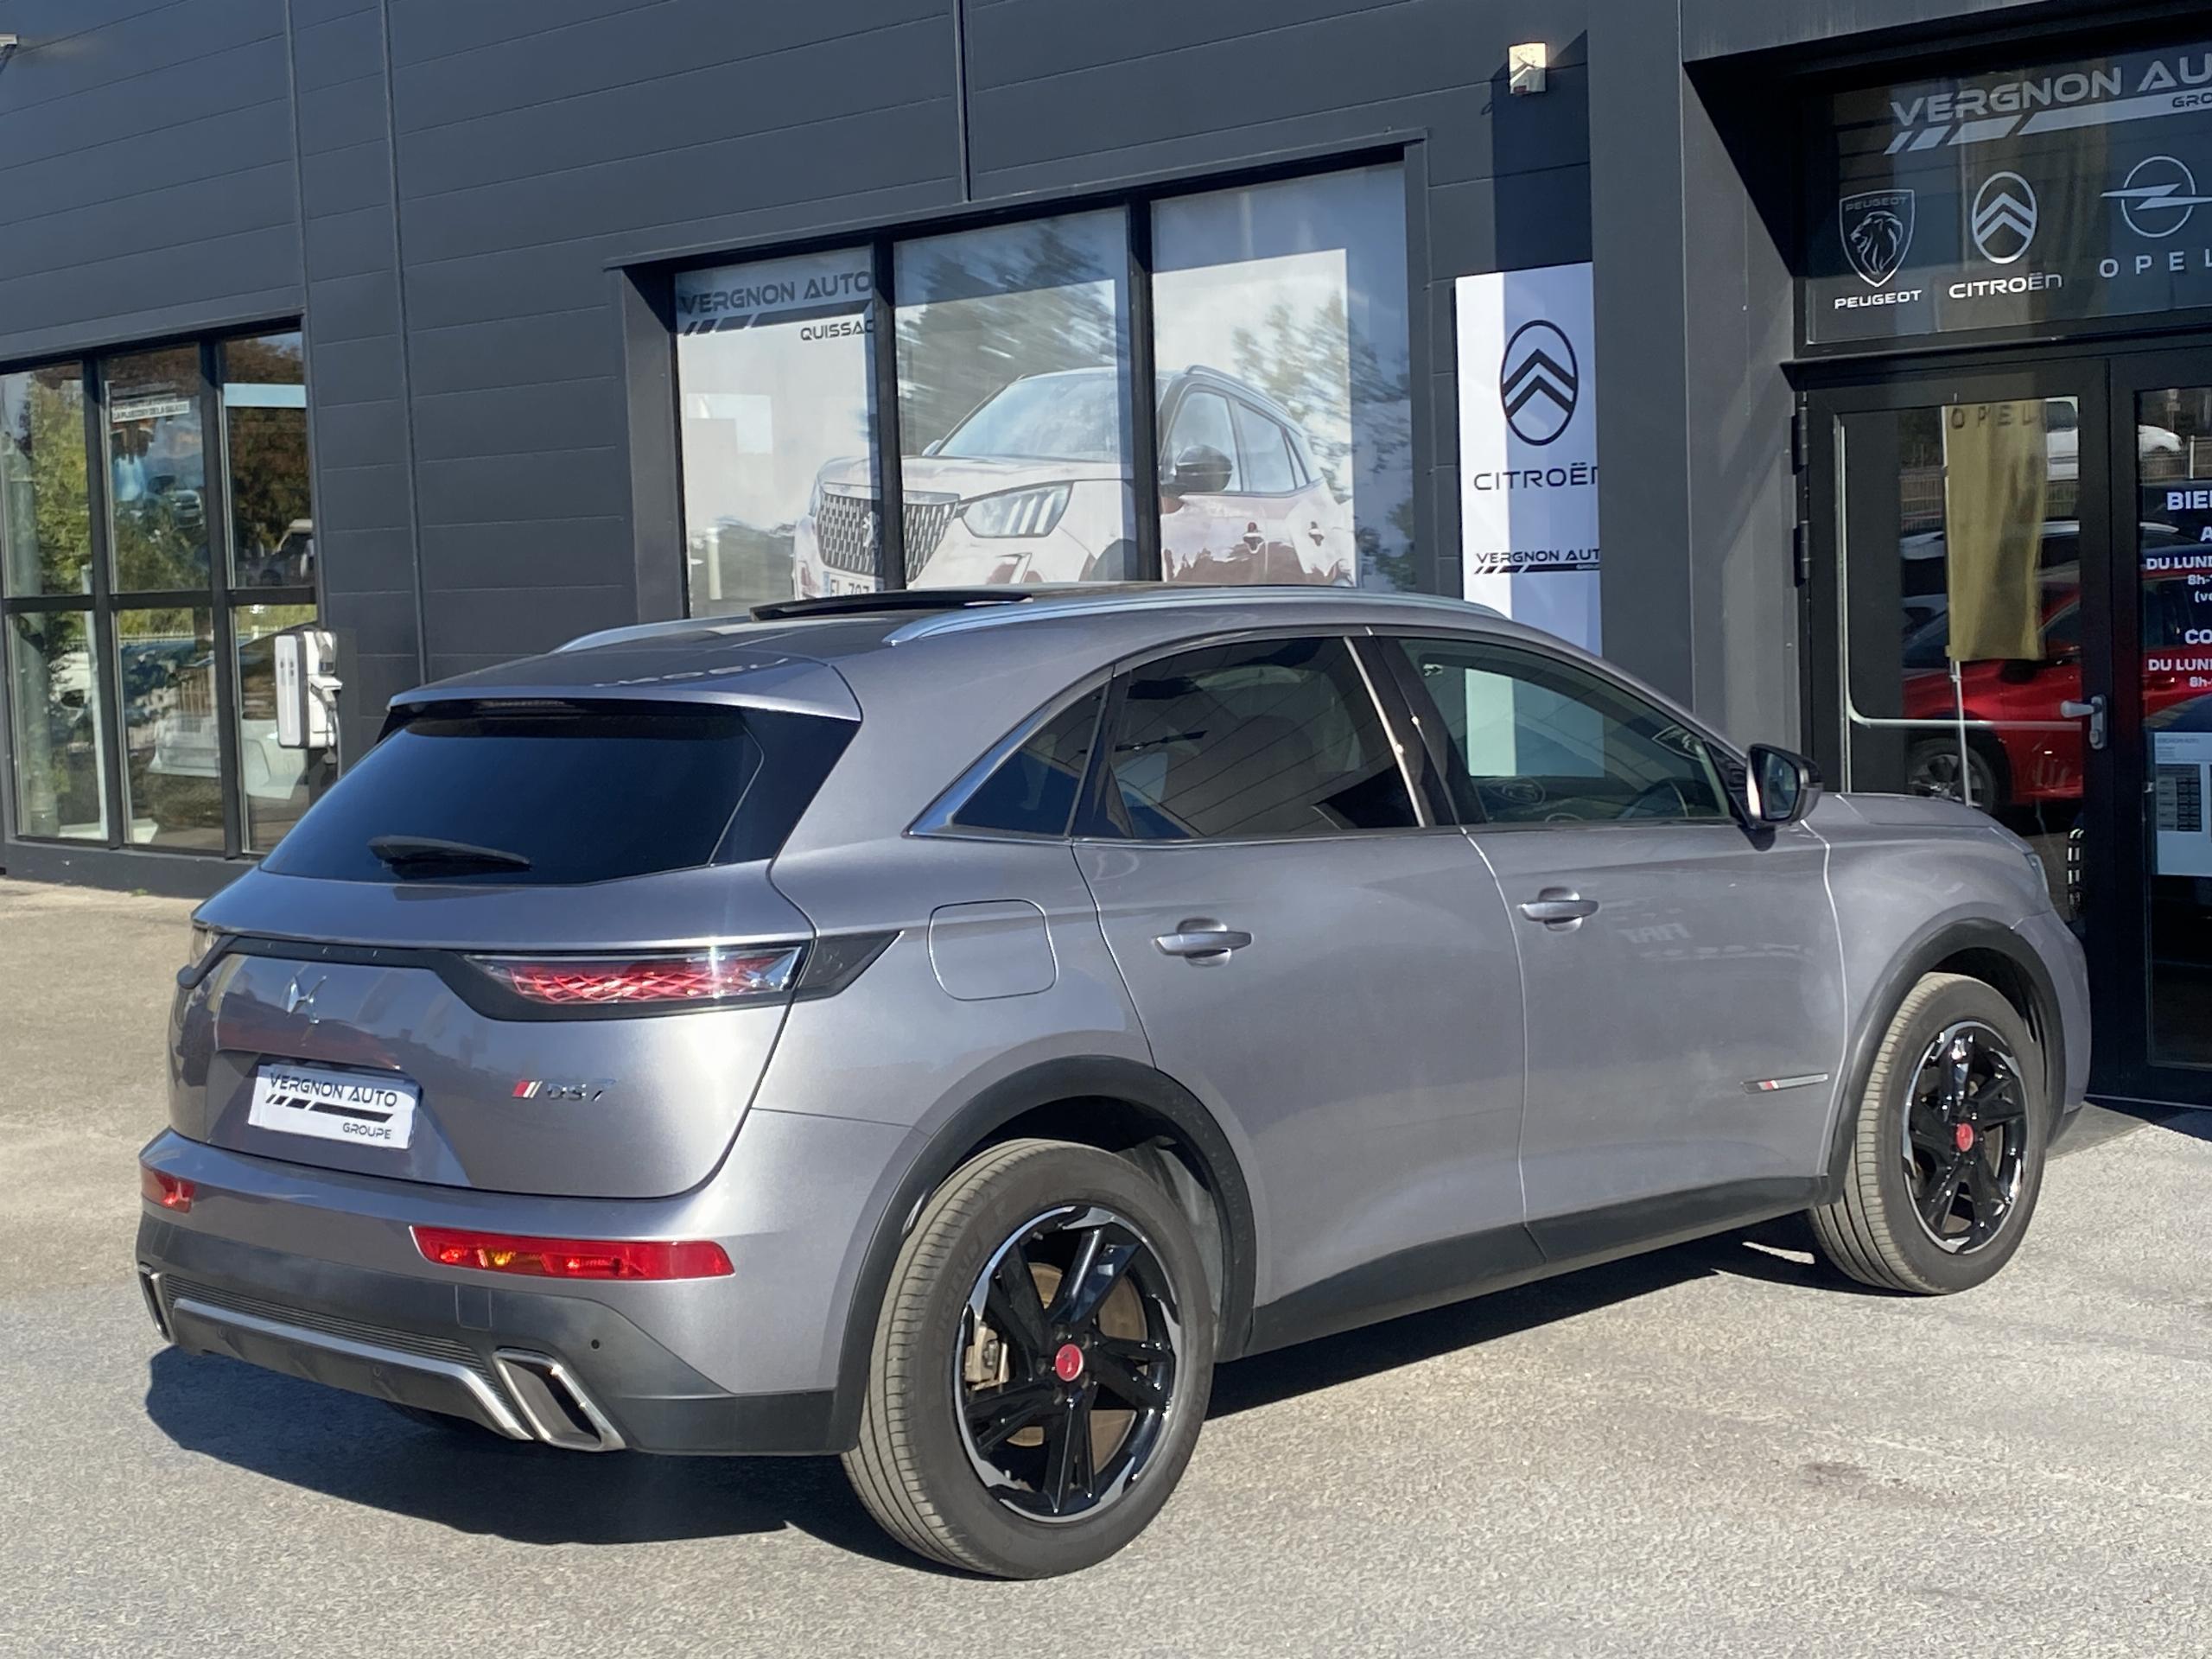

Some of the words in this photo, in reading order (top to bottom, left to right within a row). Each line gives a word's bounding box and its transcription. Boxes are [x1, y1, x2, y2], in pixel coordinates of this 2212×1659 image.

[1890, 66, 2123, 127] VERGNON
[1845, 196, 1909, 212] PEUGEOT
[677, 281, 796, 315] VERGNON
[803, 270, 873, 300] AUTO
[1834, 289, 1923, 309] PEUGEOT
[2166, 490, 2212, 511] BIE
[1476, 550, 1560, 564] VERGNON
[2145, 557, 2170, 570] DU
[2148, 658, 2172, 671] DU
[2176, 658, 2212, 671] LUN
[270, 1072, 345, 1100] VERGNON
[347, 1086, 397, 1108] AUTO
[342, 1122, 392, 1141] GROUPE
